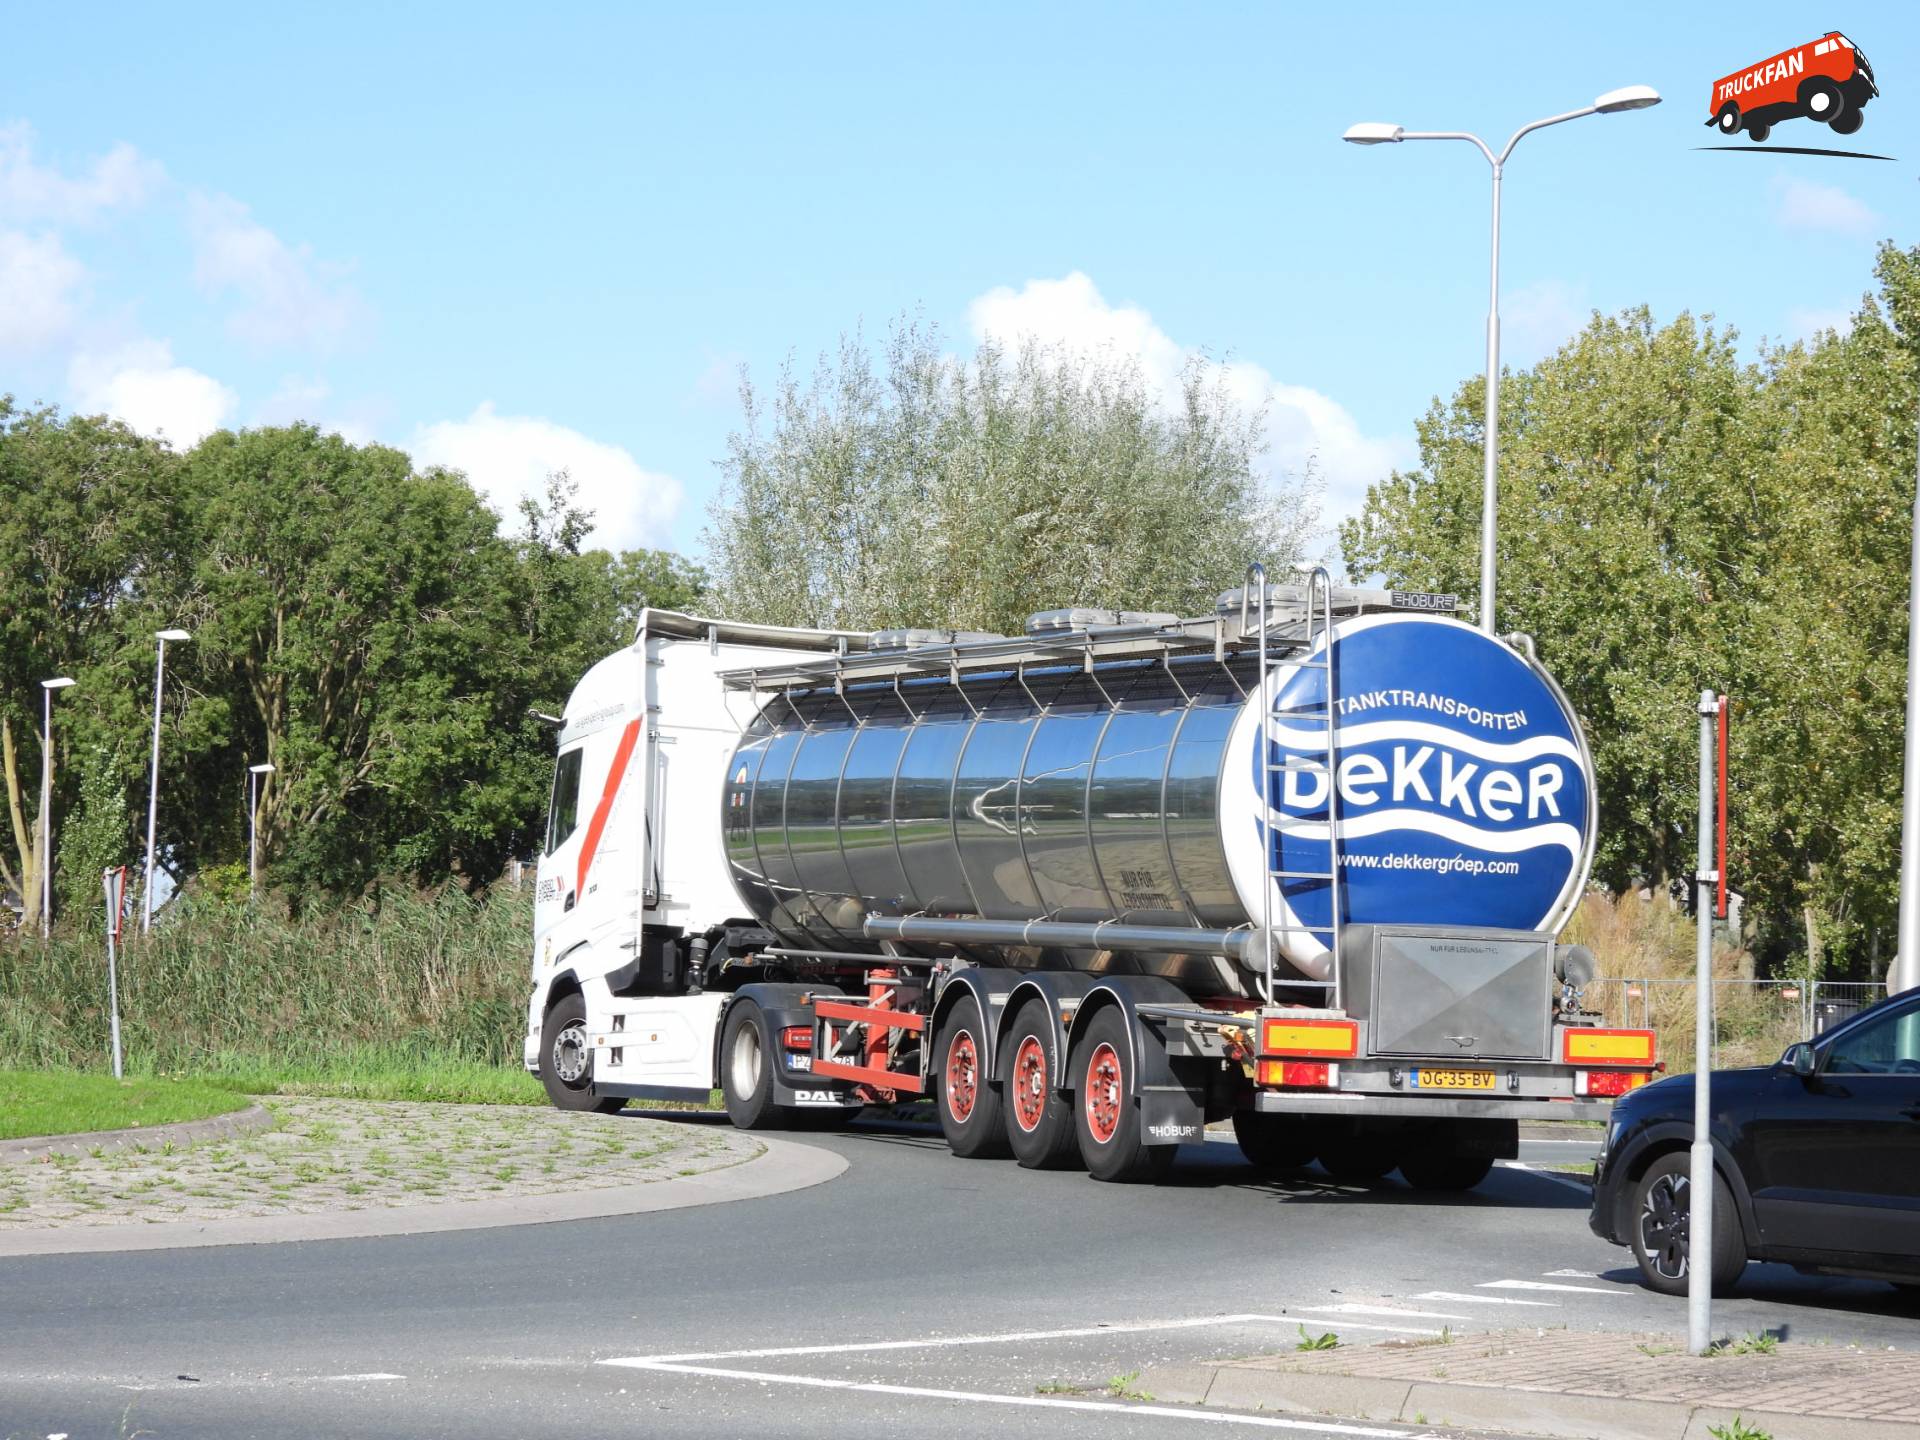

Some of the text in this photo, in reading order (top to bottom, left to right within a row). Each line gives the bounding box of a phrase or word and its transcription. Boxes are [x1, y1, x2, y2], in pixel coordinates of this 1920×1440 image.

[1402, 593, 1445, 609] HOBUR
[1333, 689, 1528, 730] TANKTRANSPORTEN
[1336, 853, 1520, 876] www.dekkergroep.com
[1422, 1070, 1491, 1087] OG-35-BV
[794, 1090, 844, 1102] DAF
[1154, 1125, 1193, 1137] HOBUR
